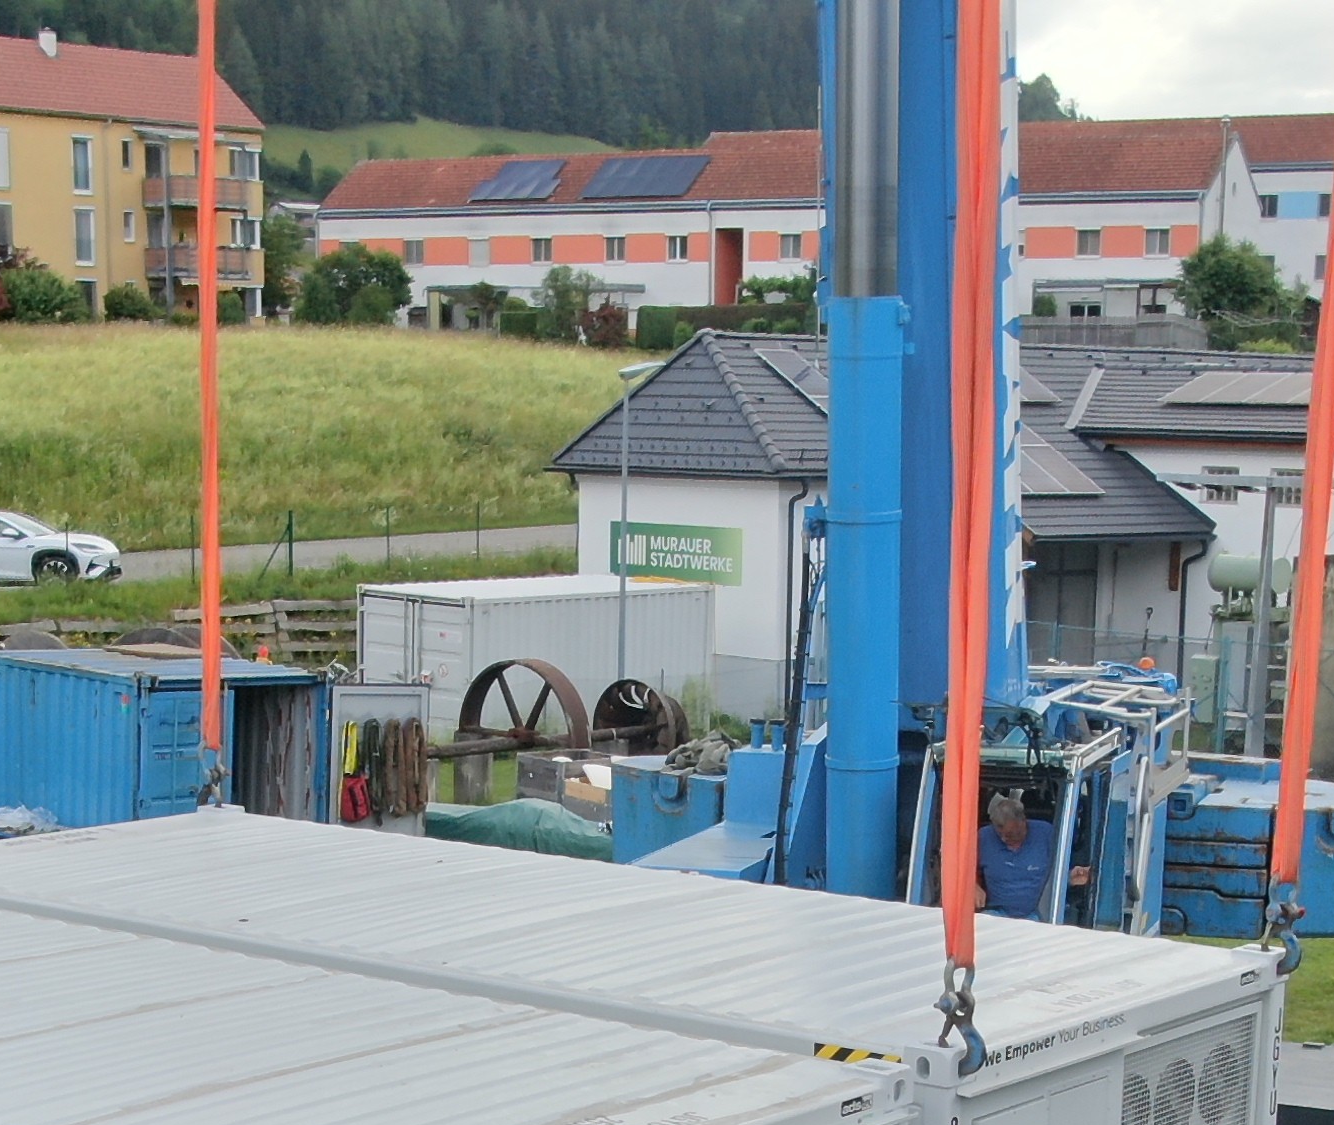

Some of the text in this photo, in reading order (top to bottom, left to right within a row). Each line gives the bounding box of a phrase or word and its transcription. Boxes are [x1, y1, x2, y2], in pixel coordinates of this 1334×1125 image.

[650, 535, 712, 554] MURAUER
[650, 551, 734, 573] STADTWERKE
[984, 1050, 1002, 1067] We
[1005, 1035, 1057, 1062] Empower
[1058, 1024, 1080, 1044] Your
